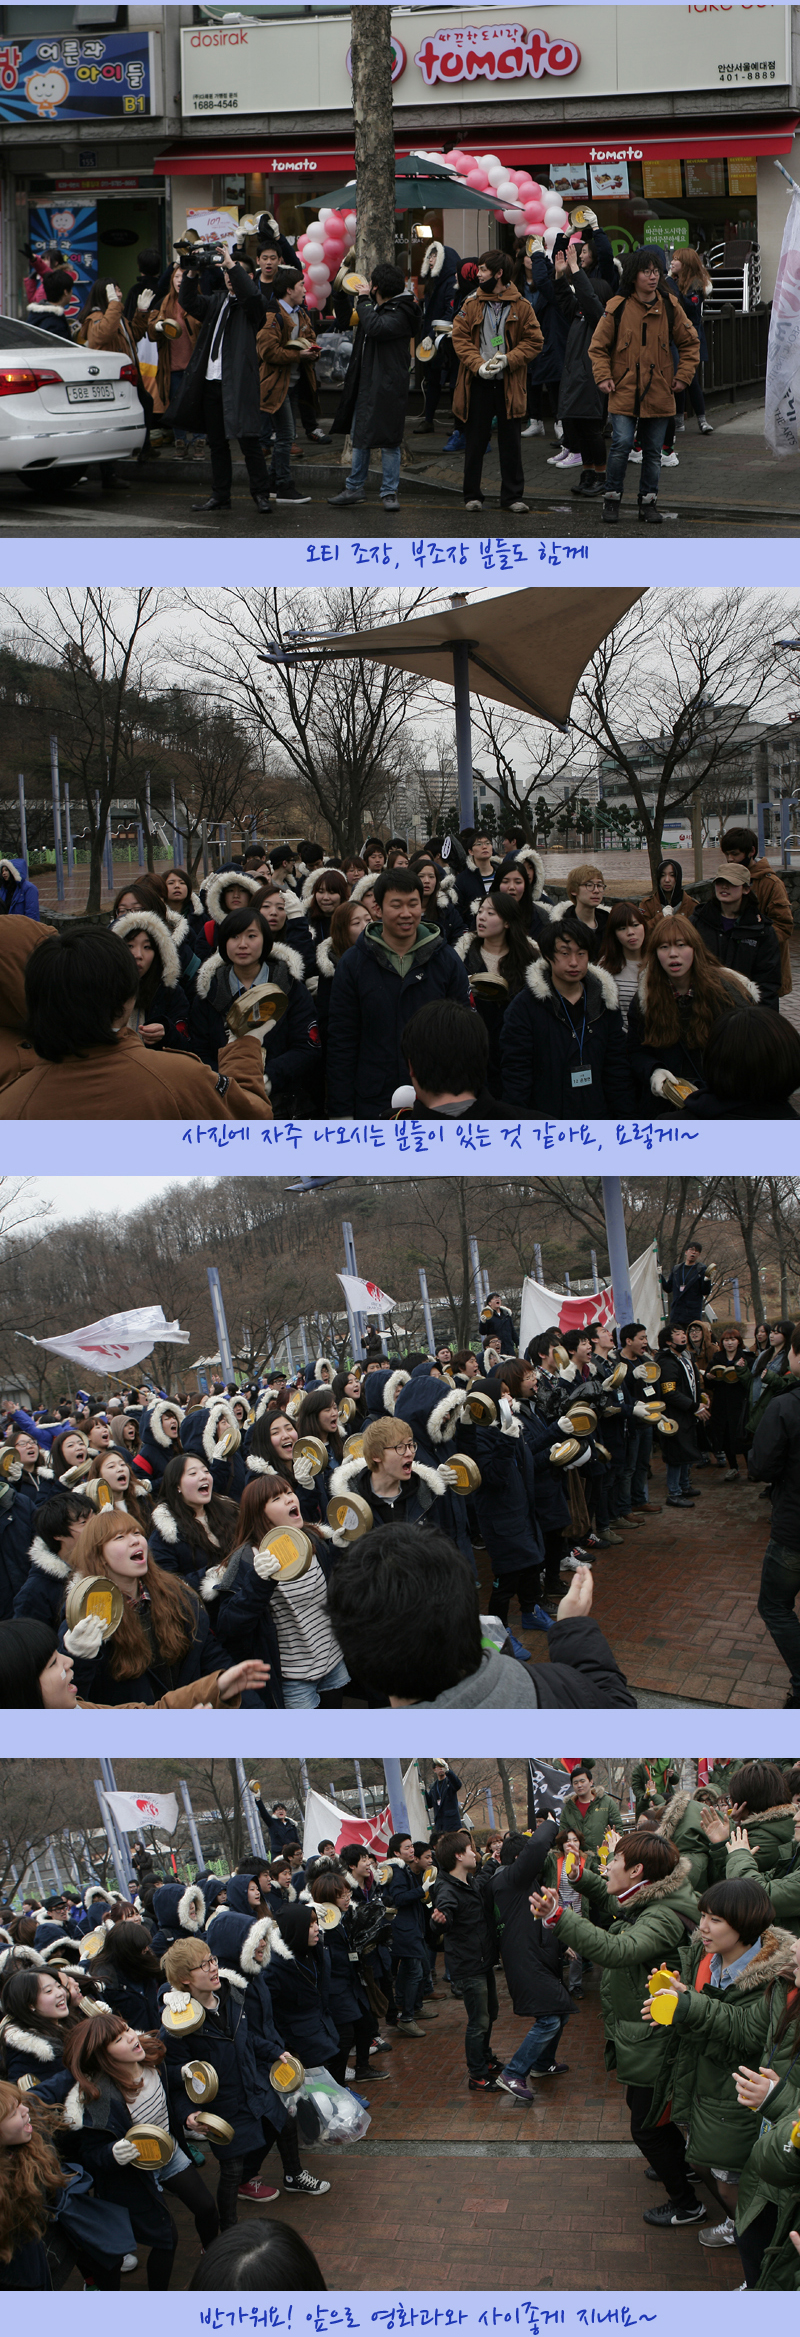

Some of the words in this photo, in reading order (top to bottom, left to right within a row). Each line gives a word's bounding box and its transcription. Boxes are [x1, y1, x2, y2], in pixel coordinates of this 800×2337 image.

[190, 28, 249, 48] dosirak
[438, 30, 478, 48] 따끈한
[481, 28, 519, 44] 도시락
[37, 39, 106, 68] 어른과
[418, 34, 573, 80] tomato
[75, 61, 145, 90] 아이들
[717, 60, 776, 73] 안산서울예대점
[719, 71, 776, 82] 401-8889
[123, 94, 146, 114] B1
[193, 99, 239, 110] 1688-4546
[589, 146, 643, 161] tomato
[271, 158, 318, 172] tomato
[92, 386, 111, 398] 5905
[781, 426, 798, 446] ARTS
